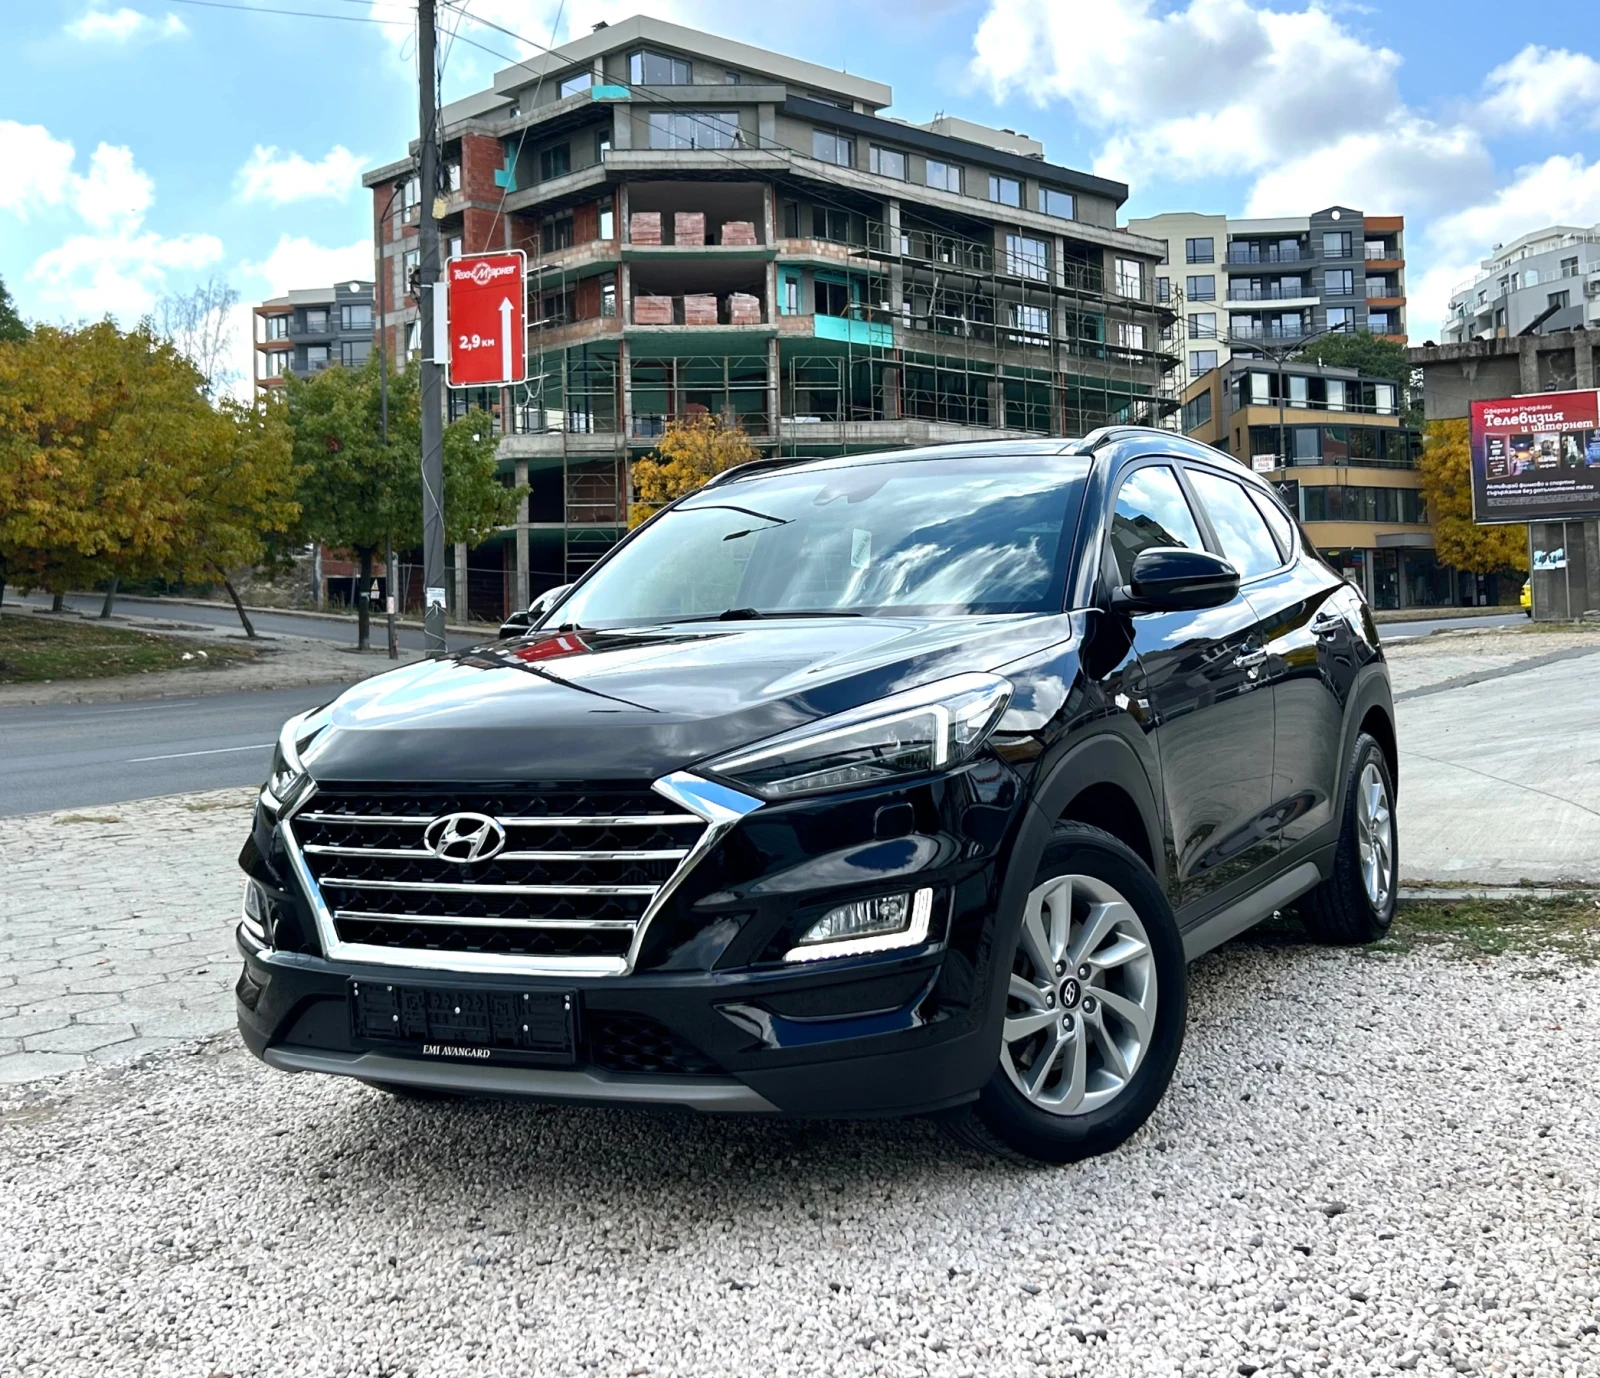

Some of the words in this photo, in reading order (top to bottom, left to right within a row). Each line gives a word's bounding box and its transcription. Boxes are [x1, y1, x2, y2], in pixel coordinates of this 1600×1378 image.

[460, 335, 480, 351] 2,9
[481, 339, 495, 347] км
[1483, 411, 1564, 427] Телевизия
[1521, 425, 1529, 433] и
[1531, 420, 1594, 432] интернет
[423, 1044, 441, 1055] EMI
[441, 1046, 491, 1059] AVANGARD
